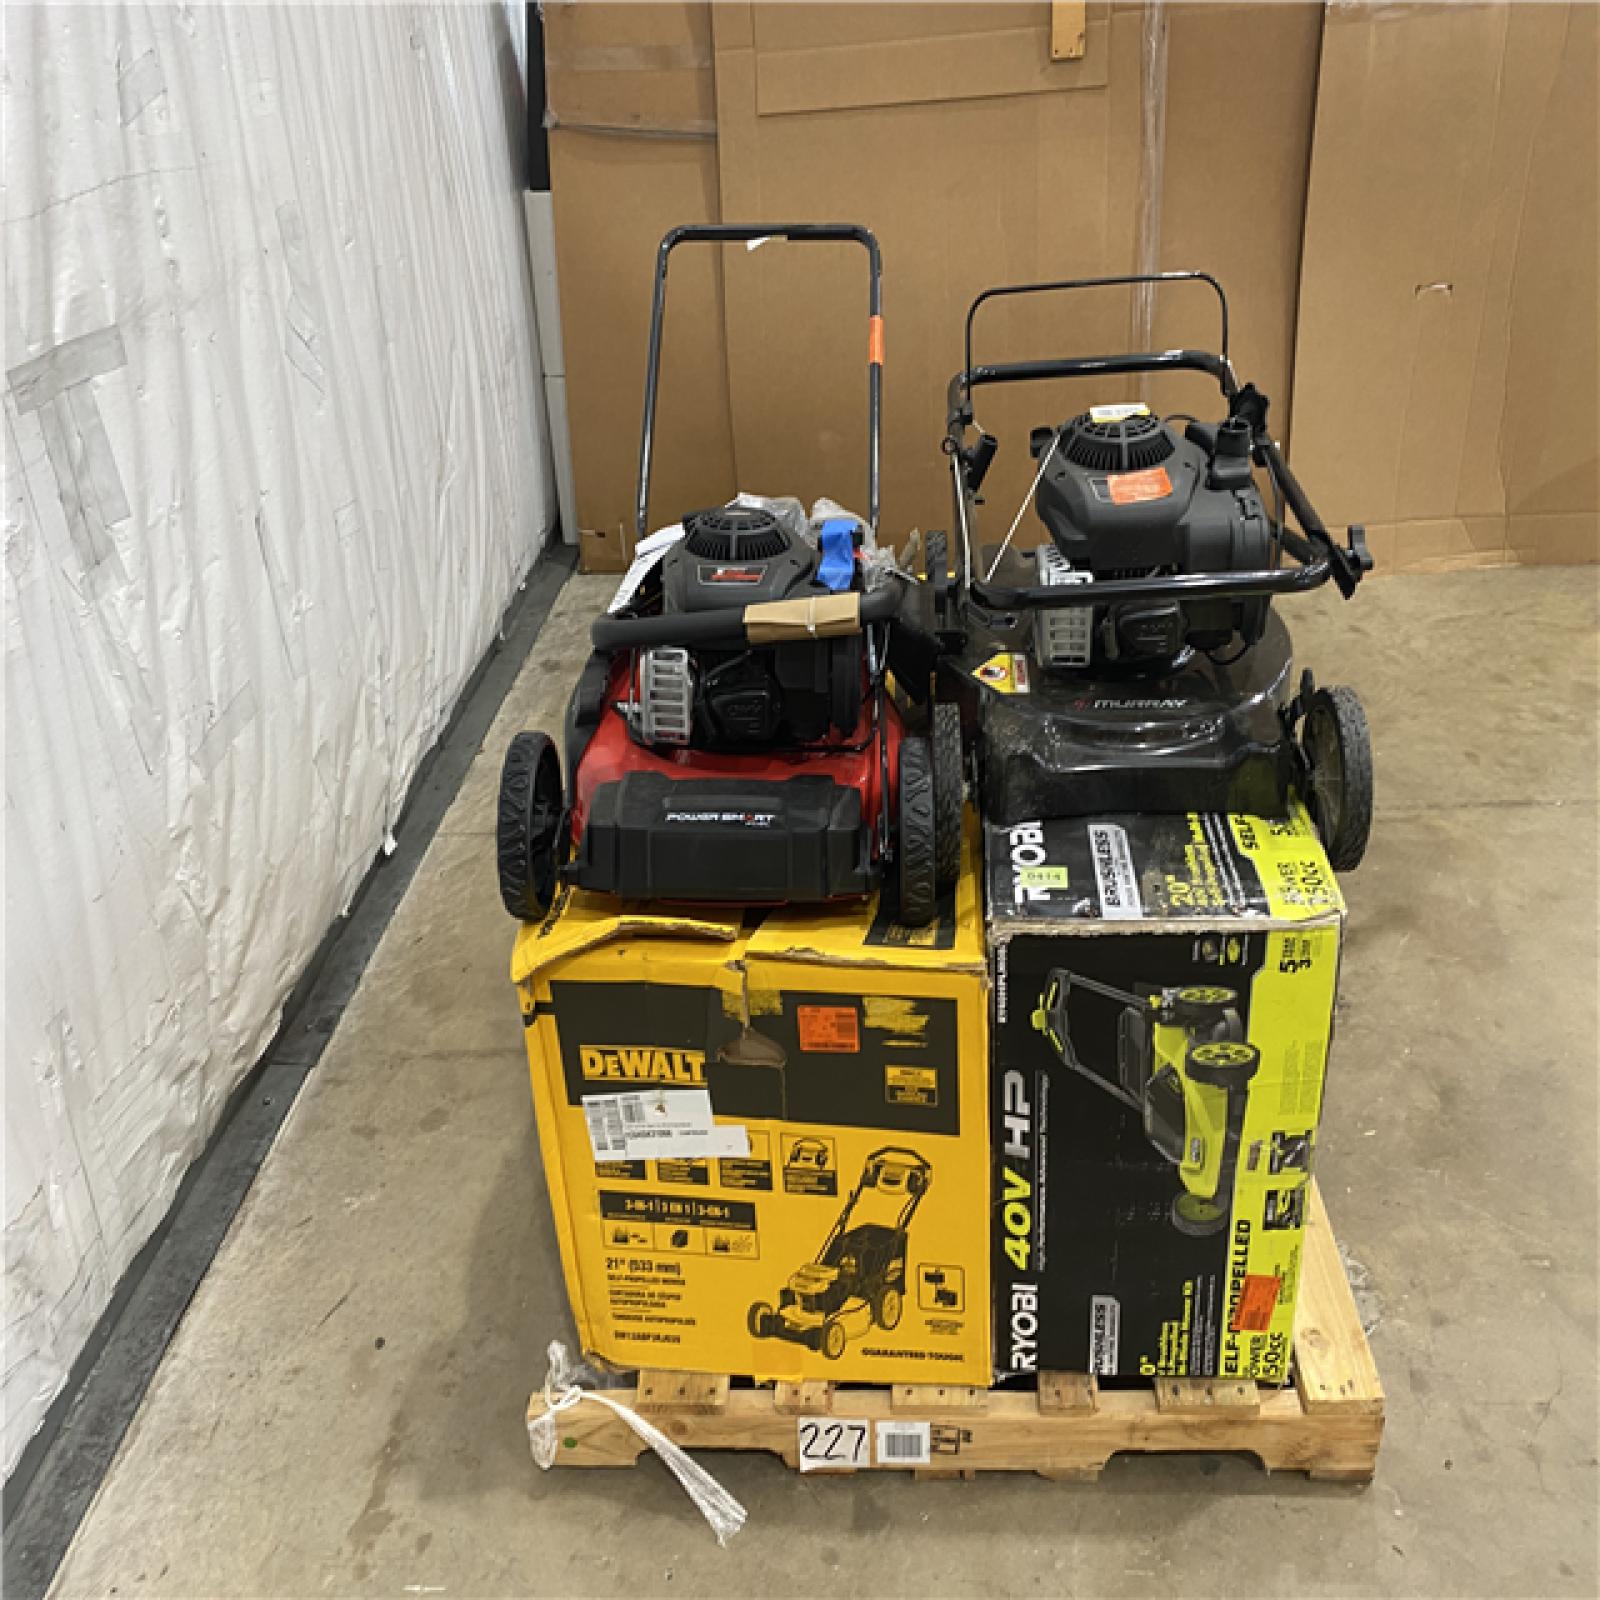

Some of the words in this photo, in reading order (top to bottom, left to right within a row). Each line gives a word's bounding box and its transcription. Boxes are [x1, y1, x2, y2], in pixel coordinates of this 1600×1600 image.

[1094, 699, 1186, 709] MURRAY
[665, 812, 718, 821] POWER
[1094, 830, 1120, 906] BRUSHLESS
[1278, 959, 1298, 973] 5
[581, 1048, 705, 1082] DEWALT
[1004, 1069, 1031, 1159] HP
[1004, 1168, 1031, 1271] 40V
[606, 1257, 626, 1270] 21"
[1011, 1283, 1038, 1371] RYOBI
[800, 1422, 866, 1462] 227
